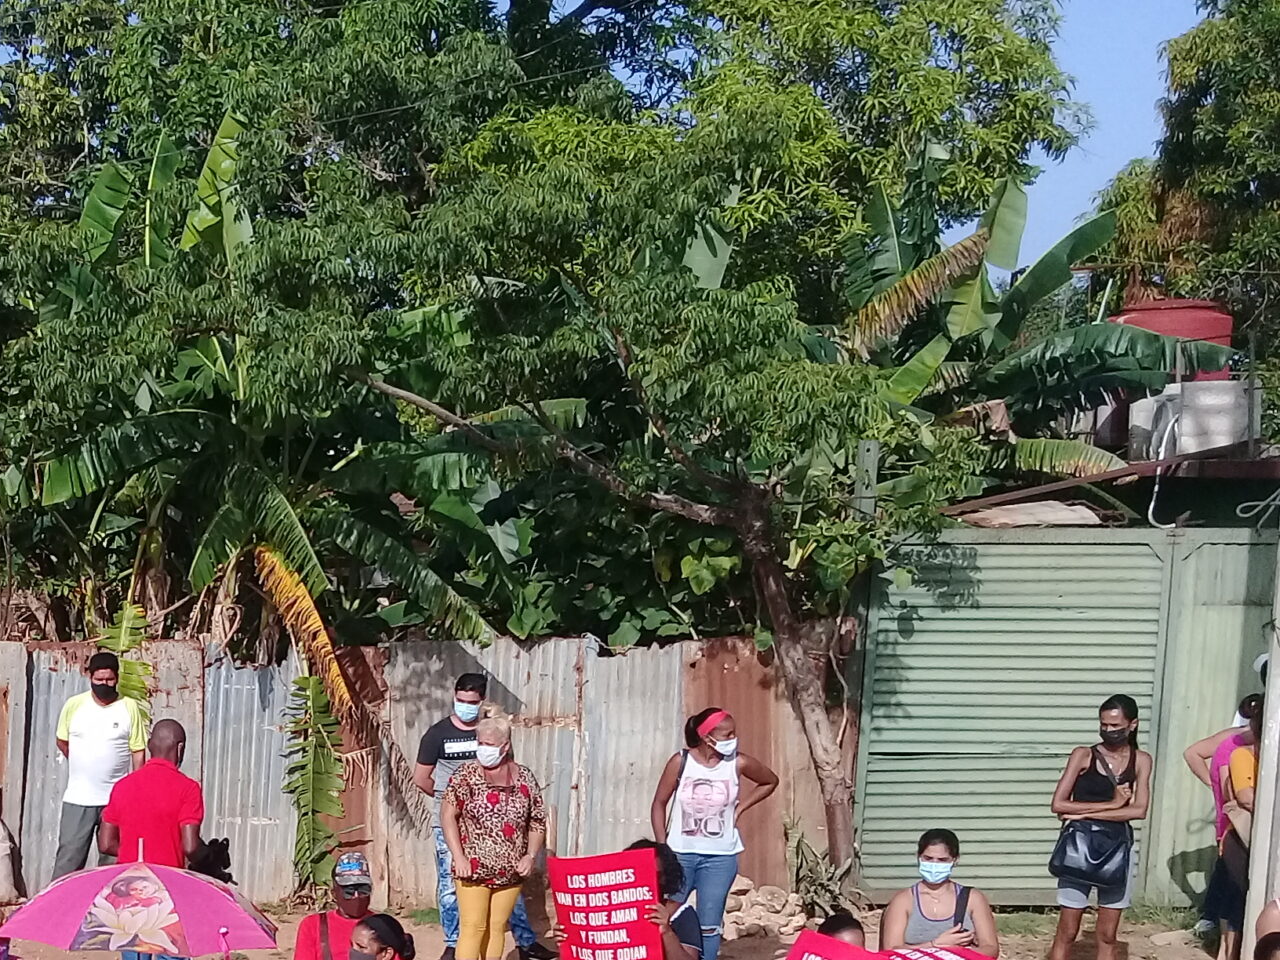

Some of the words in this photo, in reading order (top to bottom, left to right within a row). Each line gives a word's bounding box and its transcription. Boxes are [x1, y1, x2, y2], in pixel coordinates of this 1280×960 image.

[567, 874, 586, 888] LOS
[587, 868, 635, 887] HOMBRES
[555, 891, 572, 906] VAN
[573, 892, 587, 907] EN
[589, 892, 609, 907] DOS
[610, 887, 653, 903] BANDOS:
[569, 911, 587, 926] LOS
[588, 912, 609, 927] QUE
[610, 907, 638, 924] AMAN
[580, 930, 586, 943] Y
[587, 928, 631, 944] FUNDAN,
[617, 945, 648, 960] ODIAN
